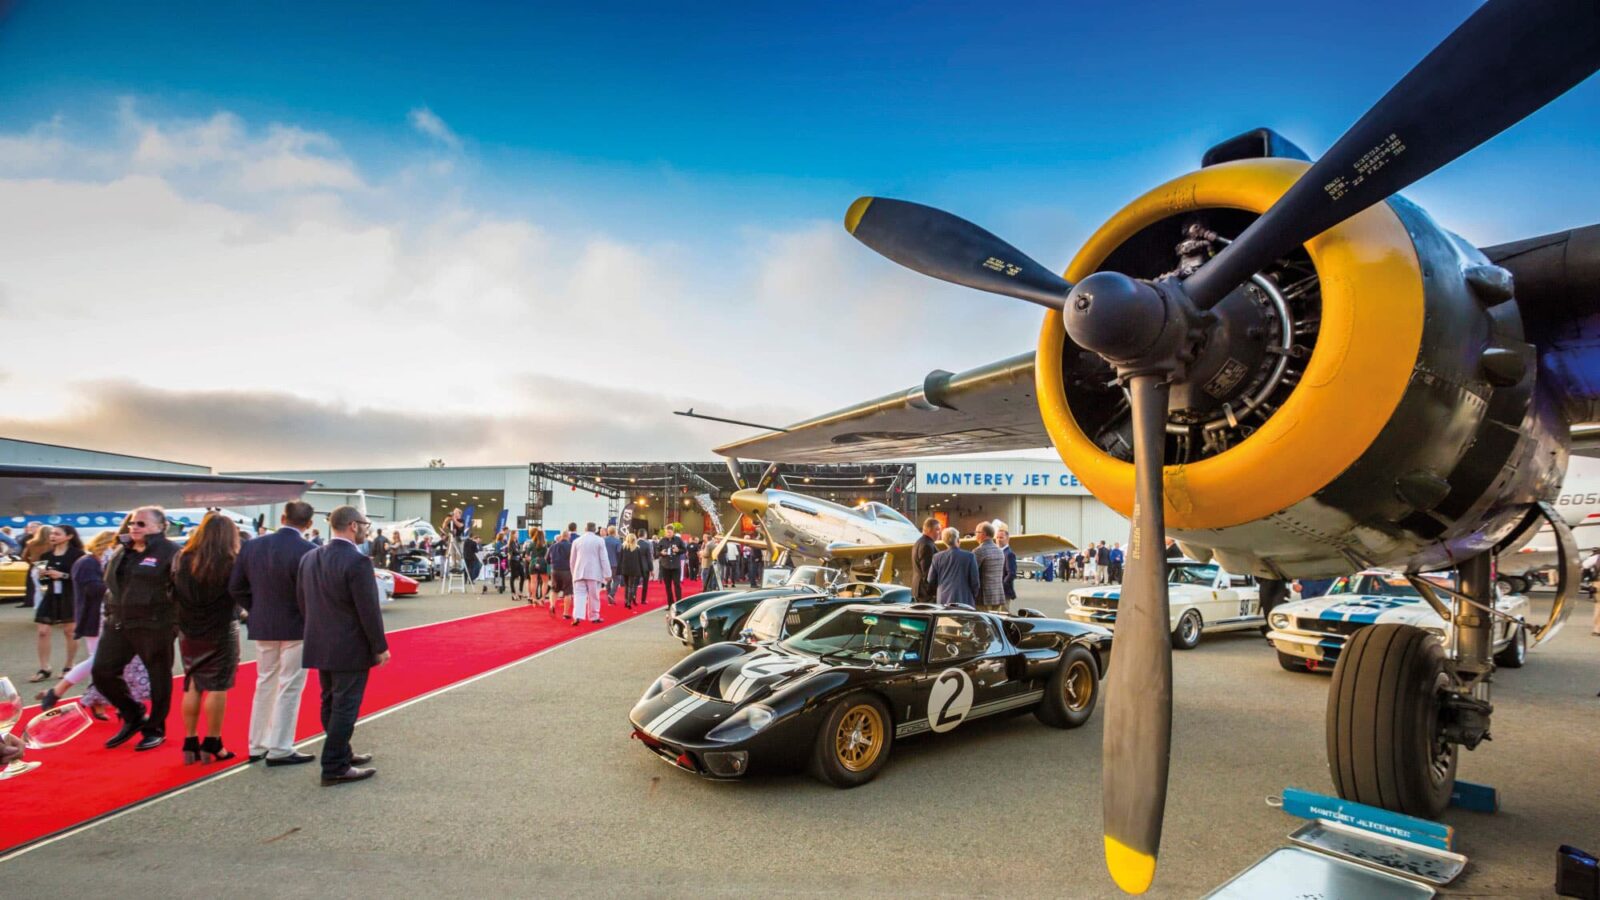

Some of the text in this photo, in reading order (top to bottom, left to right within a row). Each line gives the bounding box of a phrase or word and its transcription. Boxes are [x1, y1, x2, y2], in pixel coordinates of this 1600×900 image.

[926, 473, 1083, 487] MONTEREY JET CE
[936, 671, 964, 727] 2
[1310, 806, 1355, 822] MONTEREY
